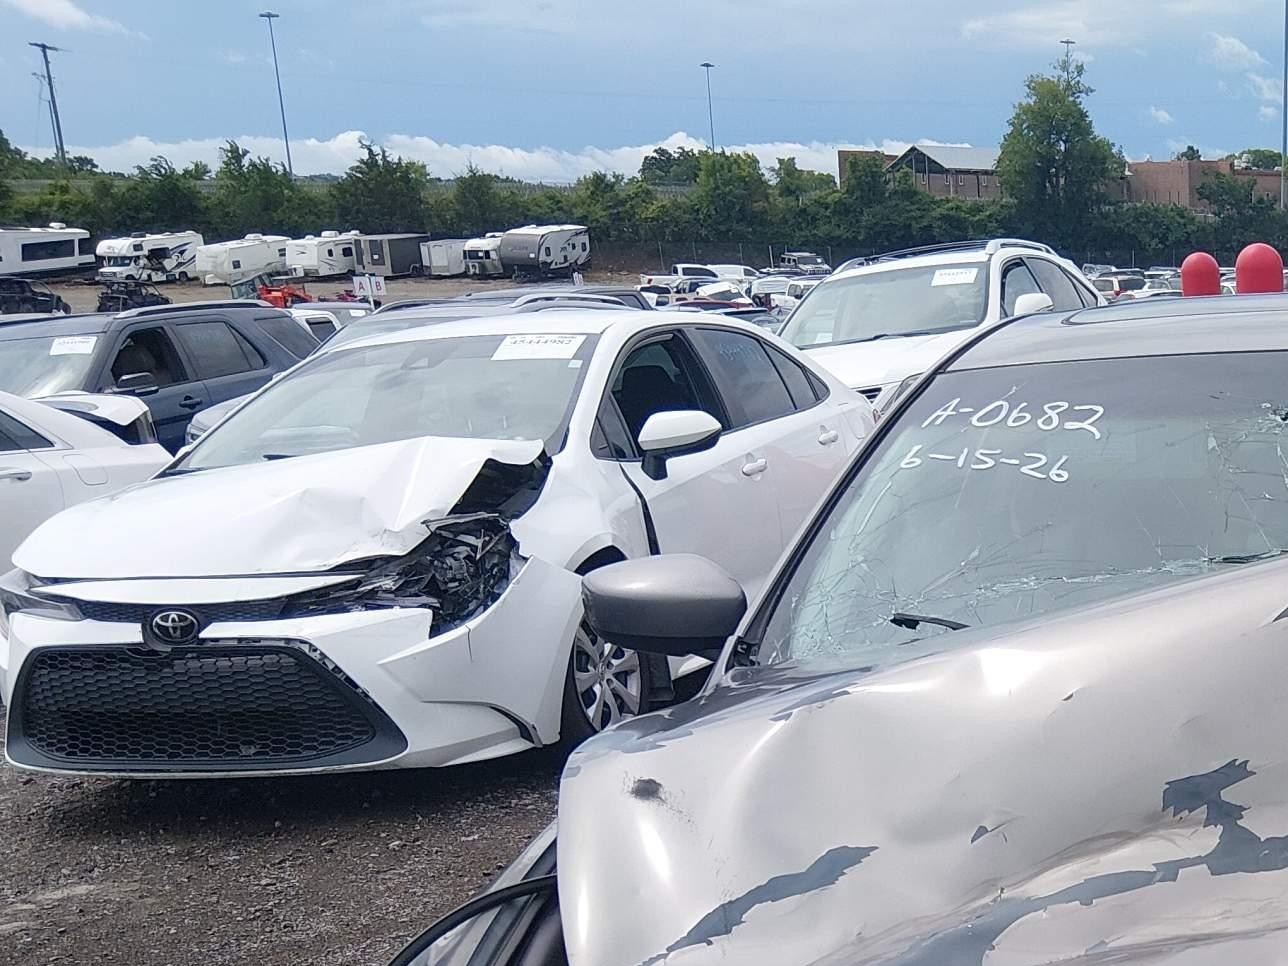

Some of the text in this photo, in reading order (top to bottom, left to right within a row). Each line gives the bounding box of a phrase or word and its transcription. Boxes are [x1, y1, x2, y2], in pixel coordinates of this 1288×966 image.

[358, 280, 366, 292] A
[375, 280, 382, 291] B
[921, 397, 1105, 440] A-0682
[900, 444, 1070, 483] 6-15-26
